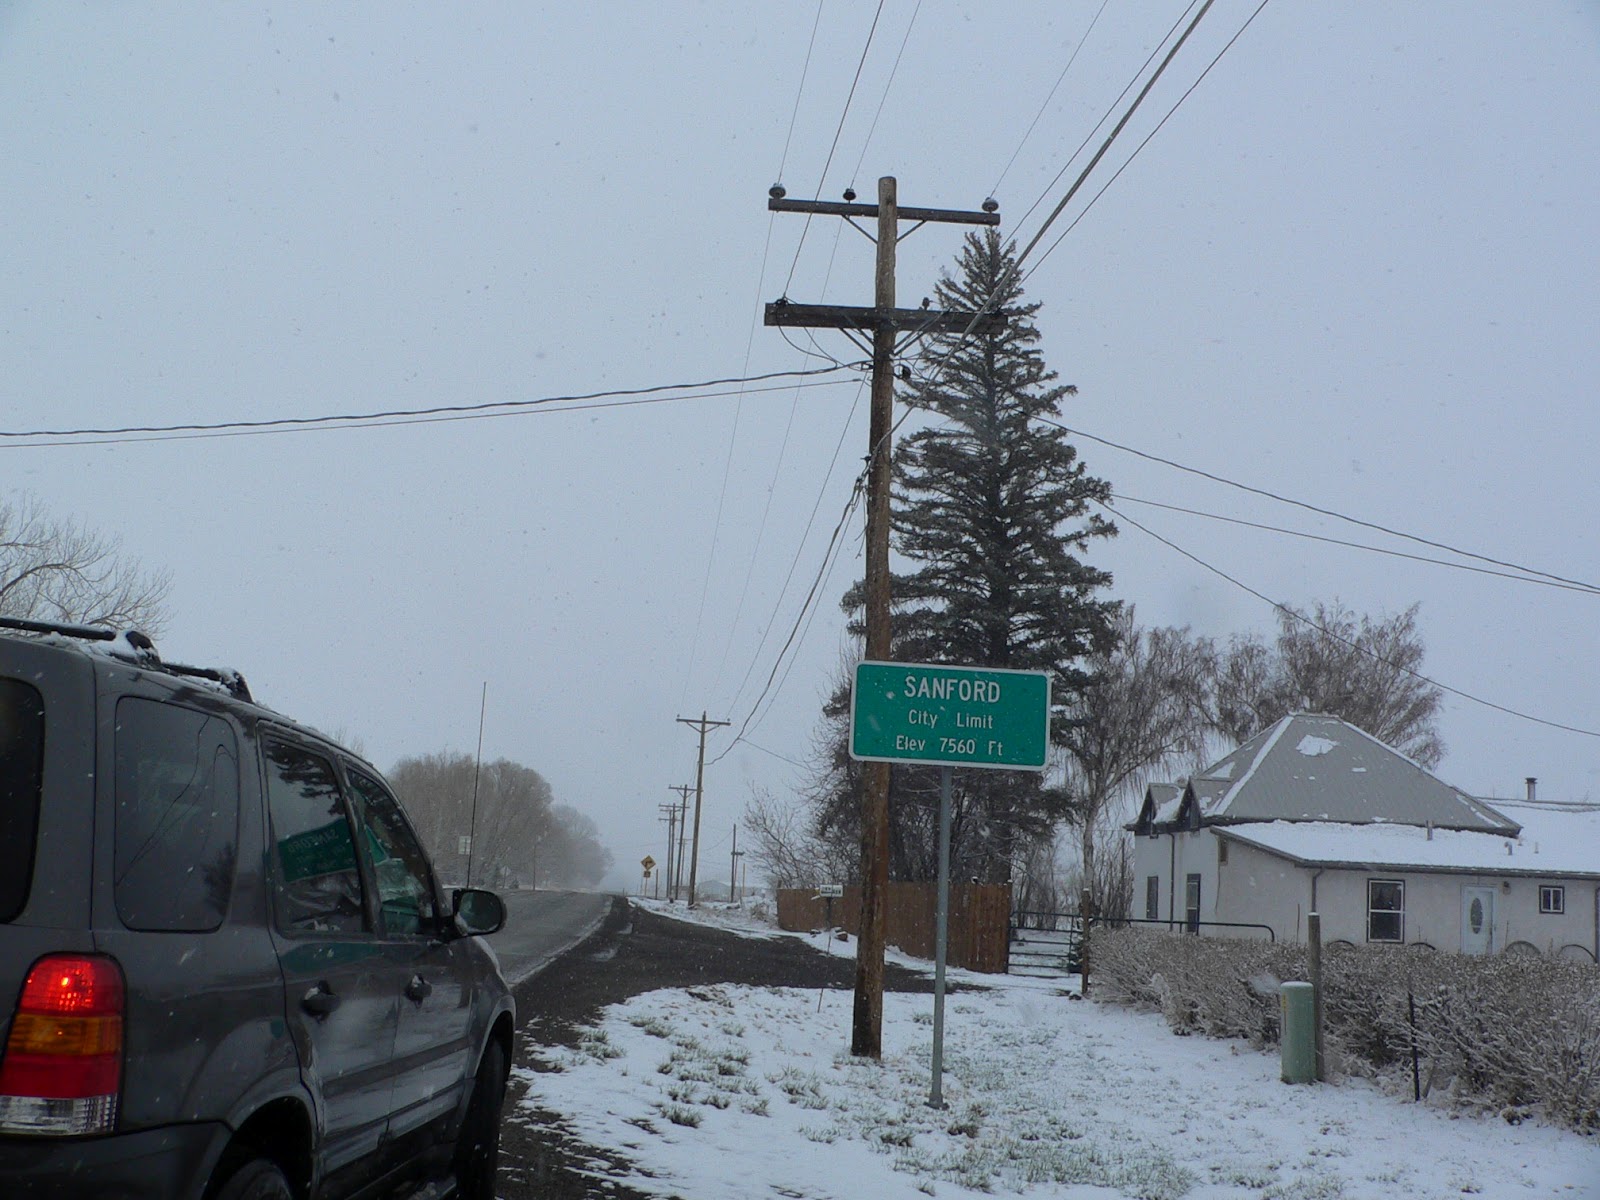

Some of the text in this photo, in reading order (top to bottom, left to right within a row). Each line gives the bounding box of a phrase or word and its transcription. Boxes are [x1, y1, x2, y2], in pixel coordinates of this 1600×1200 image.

[903, 675, 1001, 703] SANFORD
[908, 709, 993, 729] City Limit
[896, 735, 1004, 756] Elev 7560 Ft
